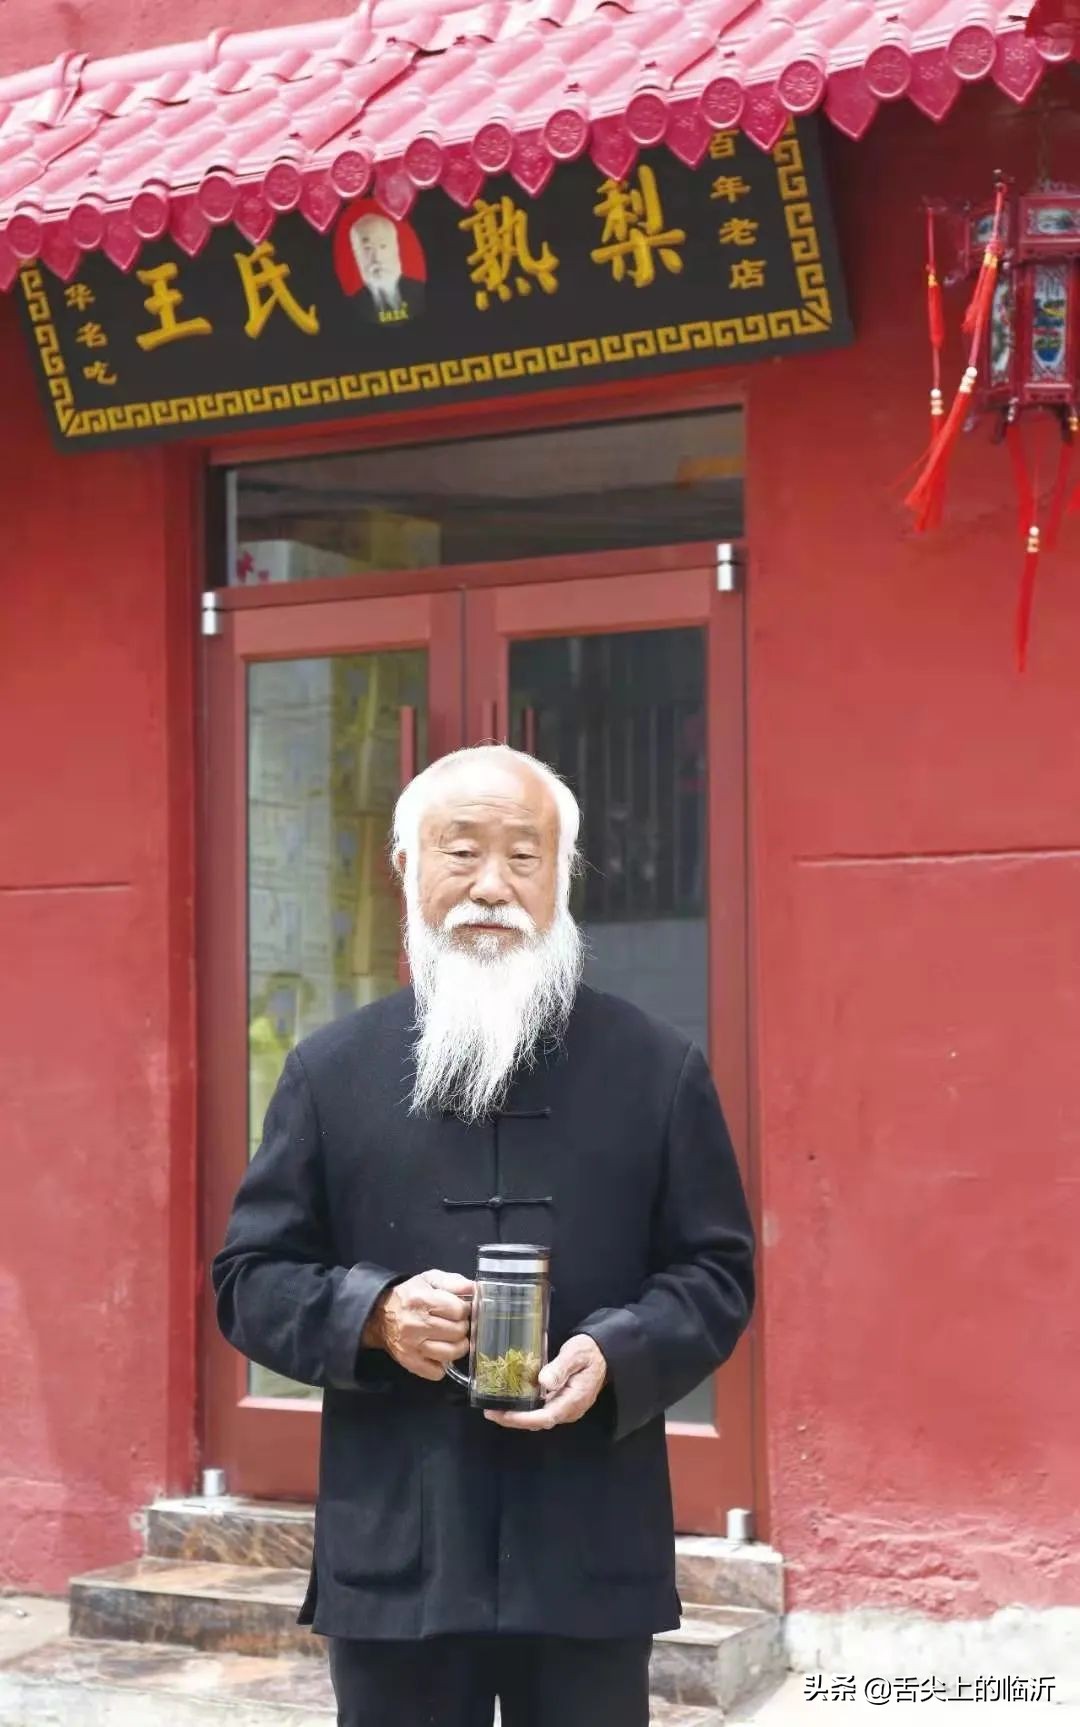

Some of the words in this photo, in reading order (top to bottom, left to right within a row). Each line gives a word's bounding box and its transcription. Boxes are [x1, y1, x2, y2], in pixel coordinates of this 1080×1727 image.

[135, 240, 320, 351] 王氏
[458, 164, 687, 311] 熟梨
[709, 128, 768, 290] 百年老店
